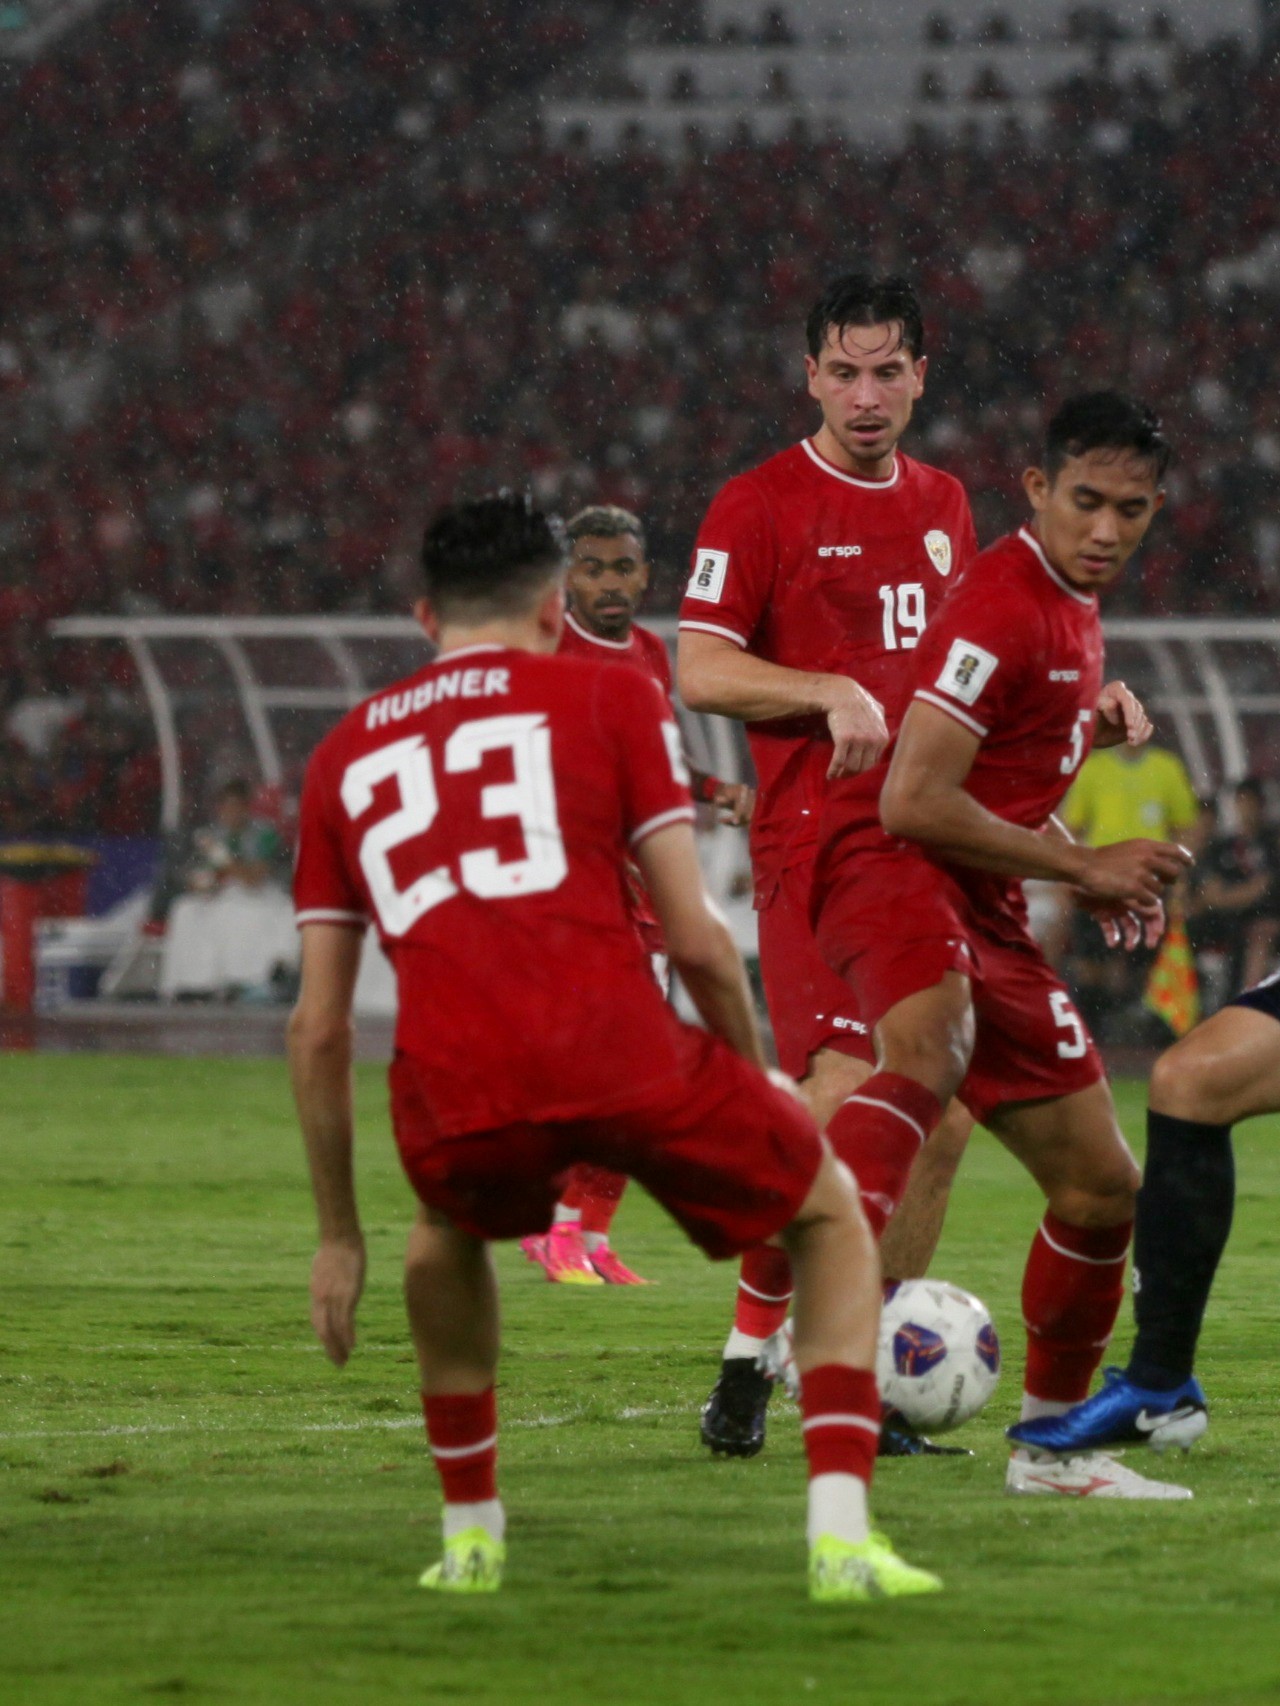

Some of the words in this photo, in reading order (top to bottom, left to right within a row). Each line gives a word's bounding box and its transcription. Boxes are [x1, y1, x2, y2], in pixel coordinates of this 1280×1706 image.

[818, 545, 862, 558] erspo
[878, 582, 927, 650] 19
[366, 667, 510, 732] HUBNER
[340, 713, 569, 937] 23
[1048, 990, 1087, 1059] 5
